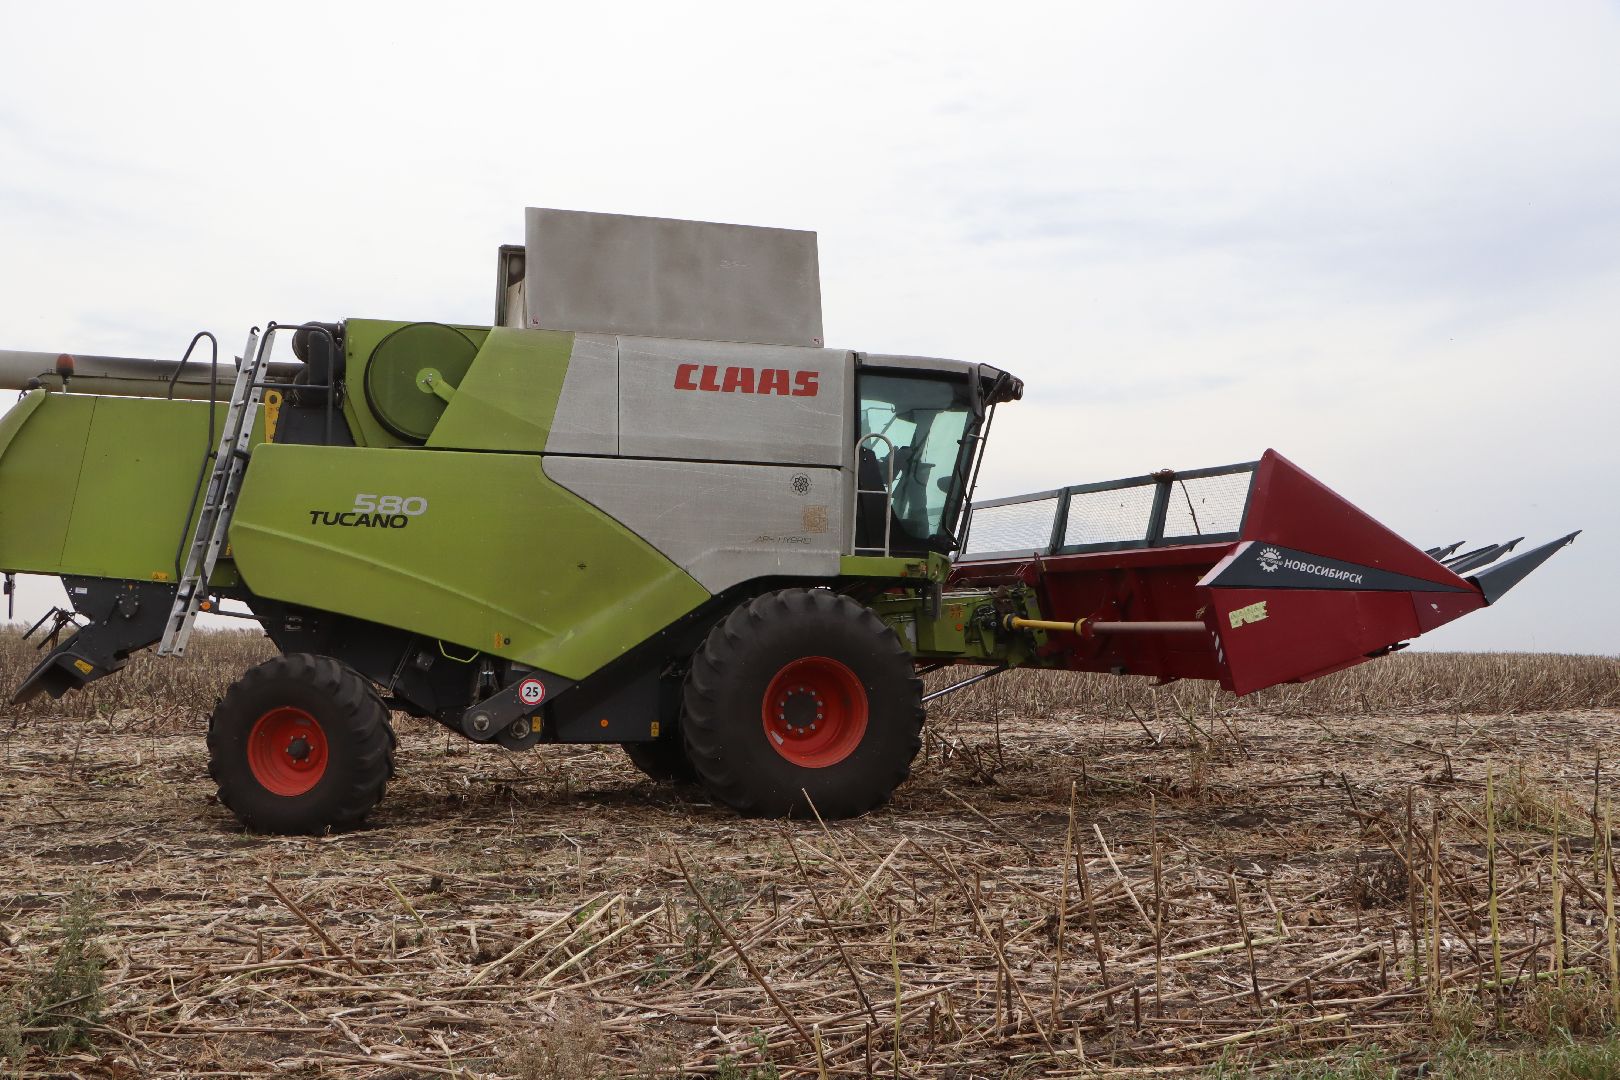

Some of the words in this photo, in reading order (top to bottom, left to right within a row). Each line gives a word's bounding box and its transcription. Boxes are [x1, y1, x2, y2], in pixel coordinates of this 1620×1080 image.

[674, 363, 819, 397] CLAAS
[352, 493, 428, 516] 580
[309, 510, 409, 529] TUCANO
[1283, 558, 1363, 585] НОВОСИБИРСК
[525, 686, 539, 697] 25
